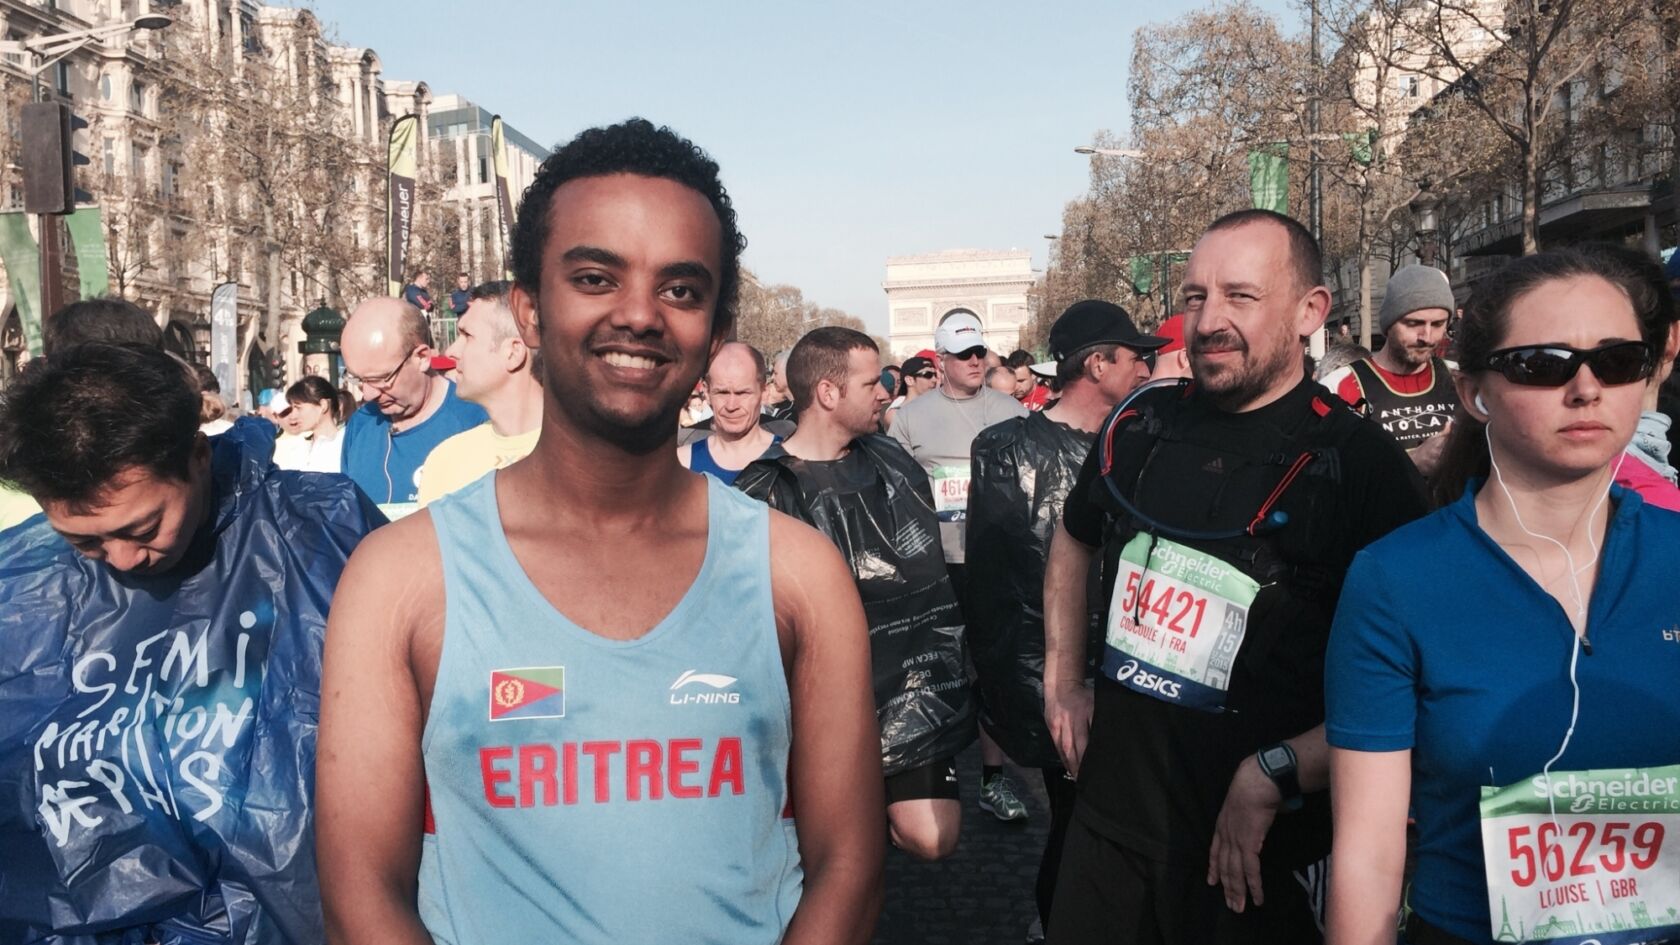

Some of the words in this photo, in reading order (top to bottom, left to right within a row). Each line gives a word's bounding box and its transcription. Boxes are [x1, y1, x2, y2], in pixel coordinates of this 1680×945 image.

[1381, 403, 1455, 418] ANTHONY
[1177, 567, 1222, 593] Electric
[1122, 571, 1207, 639] 54421
[1225, 610, 1242, 633] 4h
[1168, 636, 1187, 654] FRA
[1218, 631, 1237, 653] 15
[669, 692, 741, 705] LI-NING
[479, 737, 745, 808] ERITREA
[1532, 772, 1678, 799] Schneider
[1598, 798, 1680, 811] Electric
[1508, 821, 1665, 888] 56259
[1610, 878, 1638, 899] GBR
